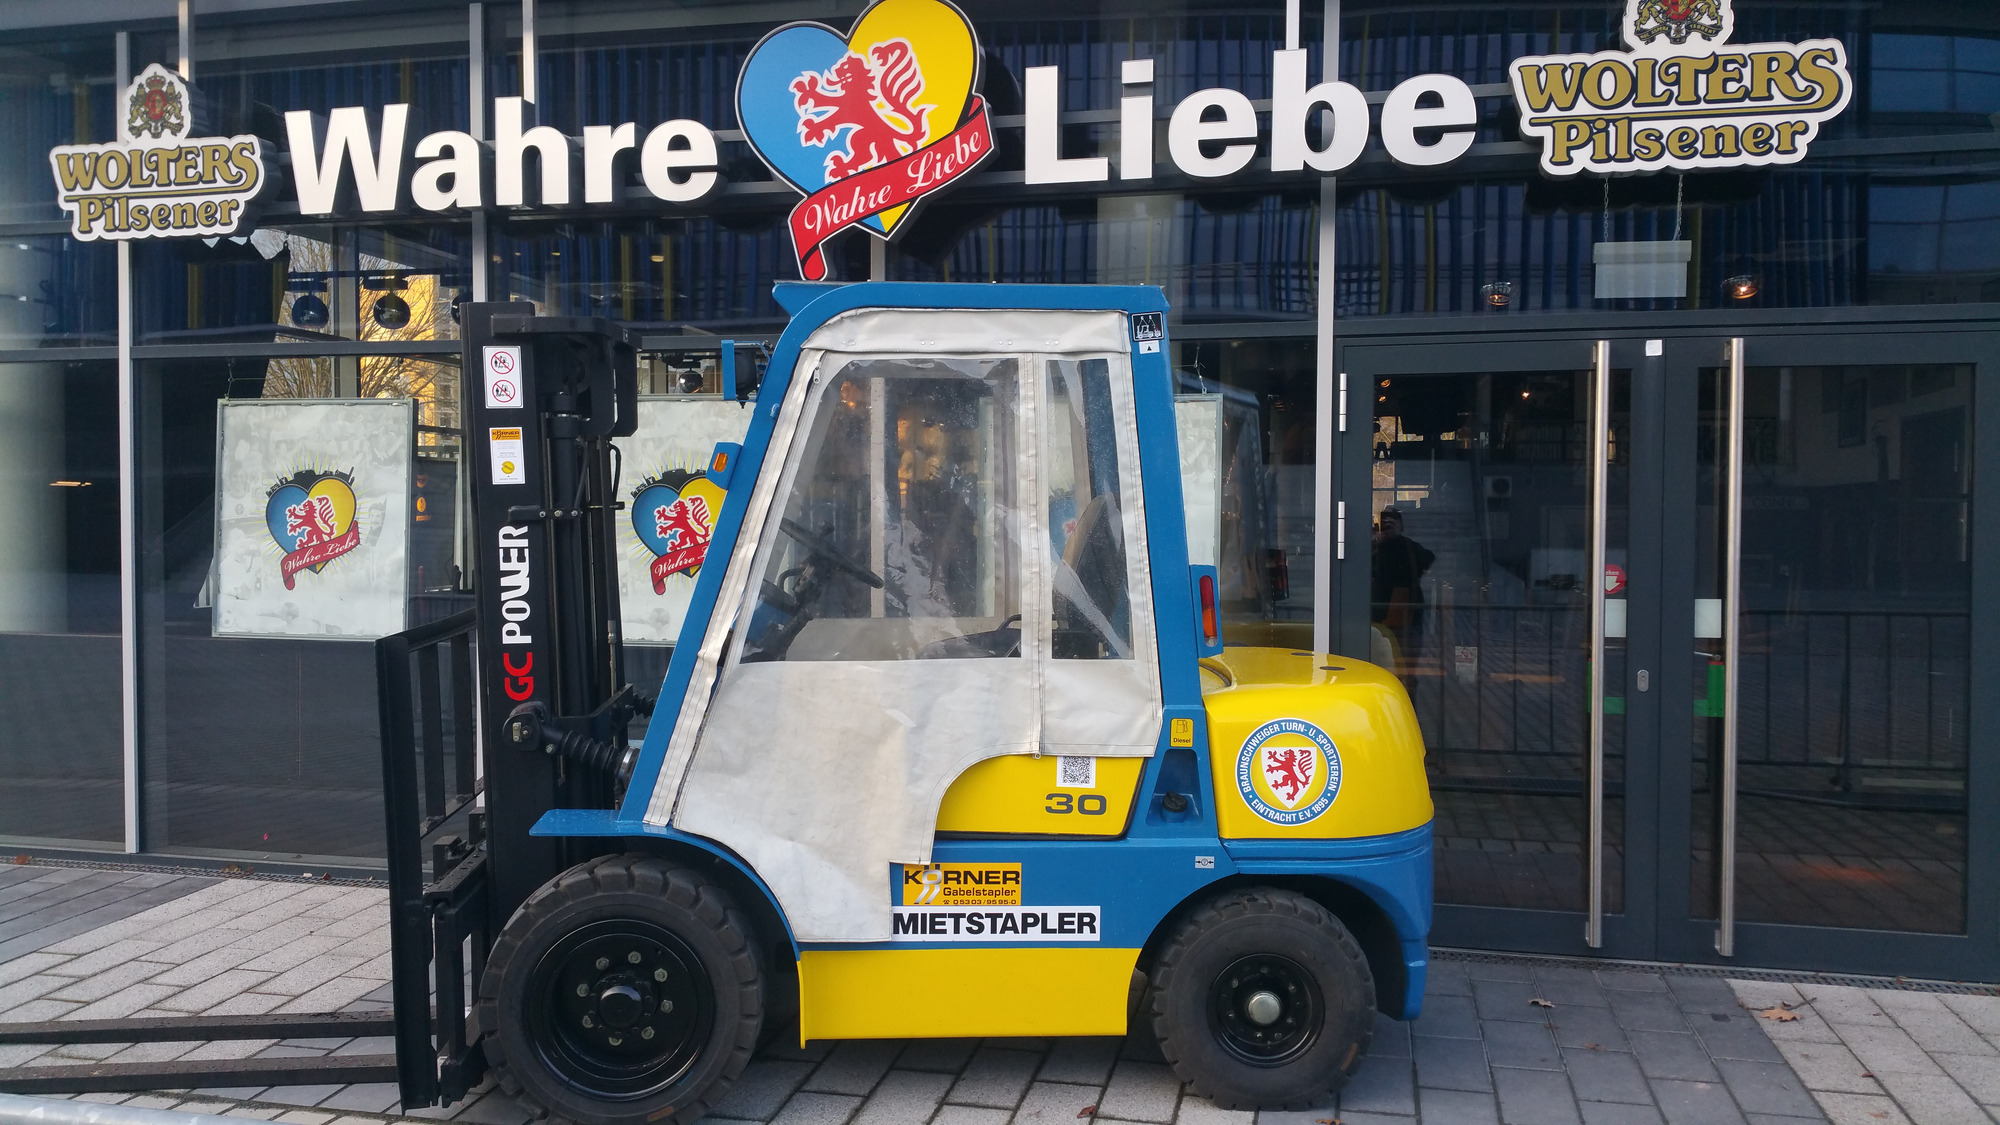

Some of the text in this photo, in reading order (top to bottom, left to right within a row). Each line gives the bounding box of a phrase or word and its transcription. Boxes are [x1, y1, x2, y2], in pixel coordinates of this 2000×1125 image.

[1518, 48, 1843, 112] WOLTERS
[285, 49, 1477, 214] Wahre Liebe
[1550, 117, 1809, 164] Pilsener
[56, 142, 259, 191] WOLTERS
[804, 131, 982, 234] Wahre Liebe
[77, 196, 239, 233] Pilsener
[284, 531, 357, 572] Wahre Liebe
[654, 550, 695, 576] Wahre
[498, 525, 534, 701] GC POWER
[1240, 722, 1339, 793] BRAUNSCHWEIGER TURN- U. SPORTVEREIN
[1045, 793, 1107, 816] 30
[1251, 797, 1329, 822] EINTRACHT E.V. 1895
[904, 864, 1020, 885] KÖRNER
[943, 887, 1016, 898] Gabelstapler
[893, 912, 1096, 935] MIETSTAPLER
